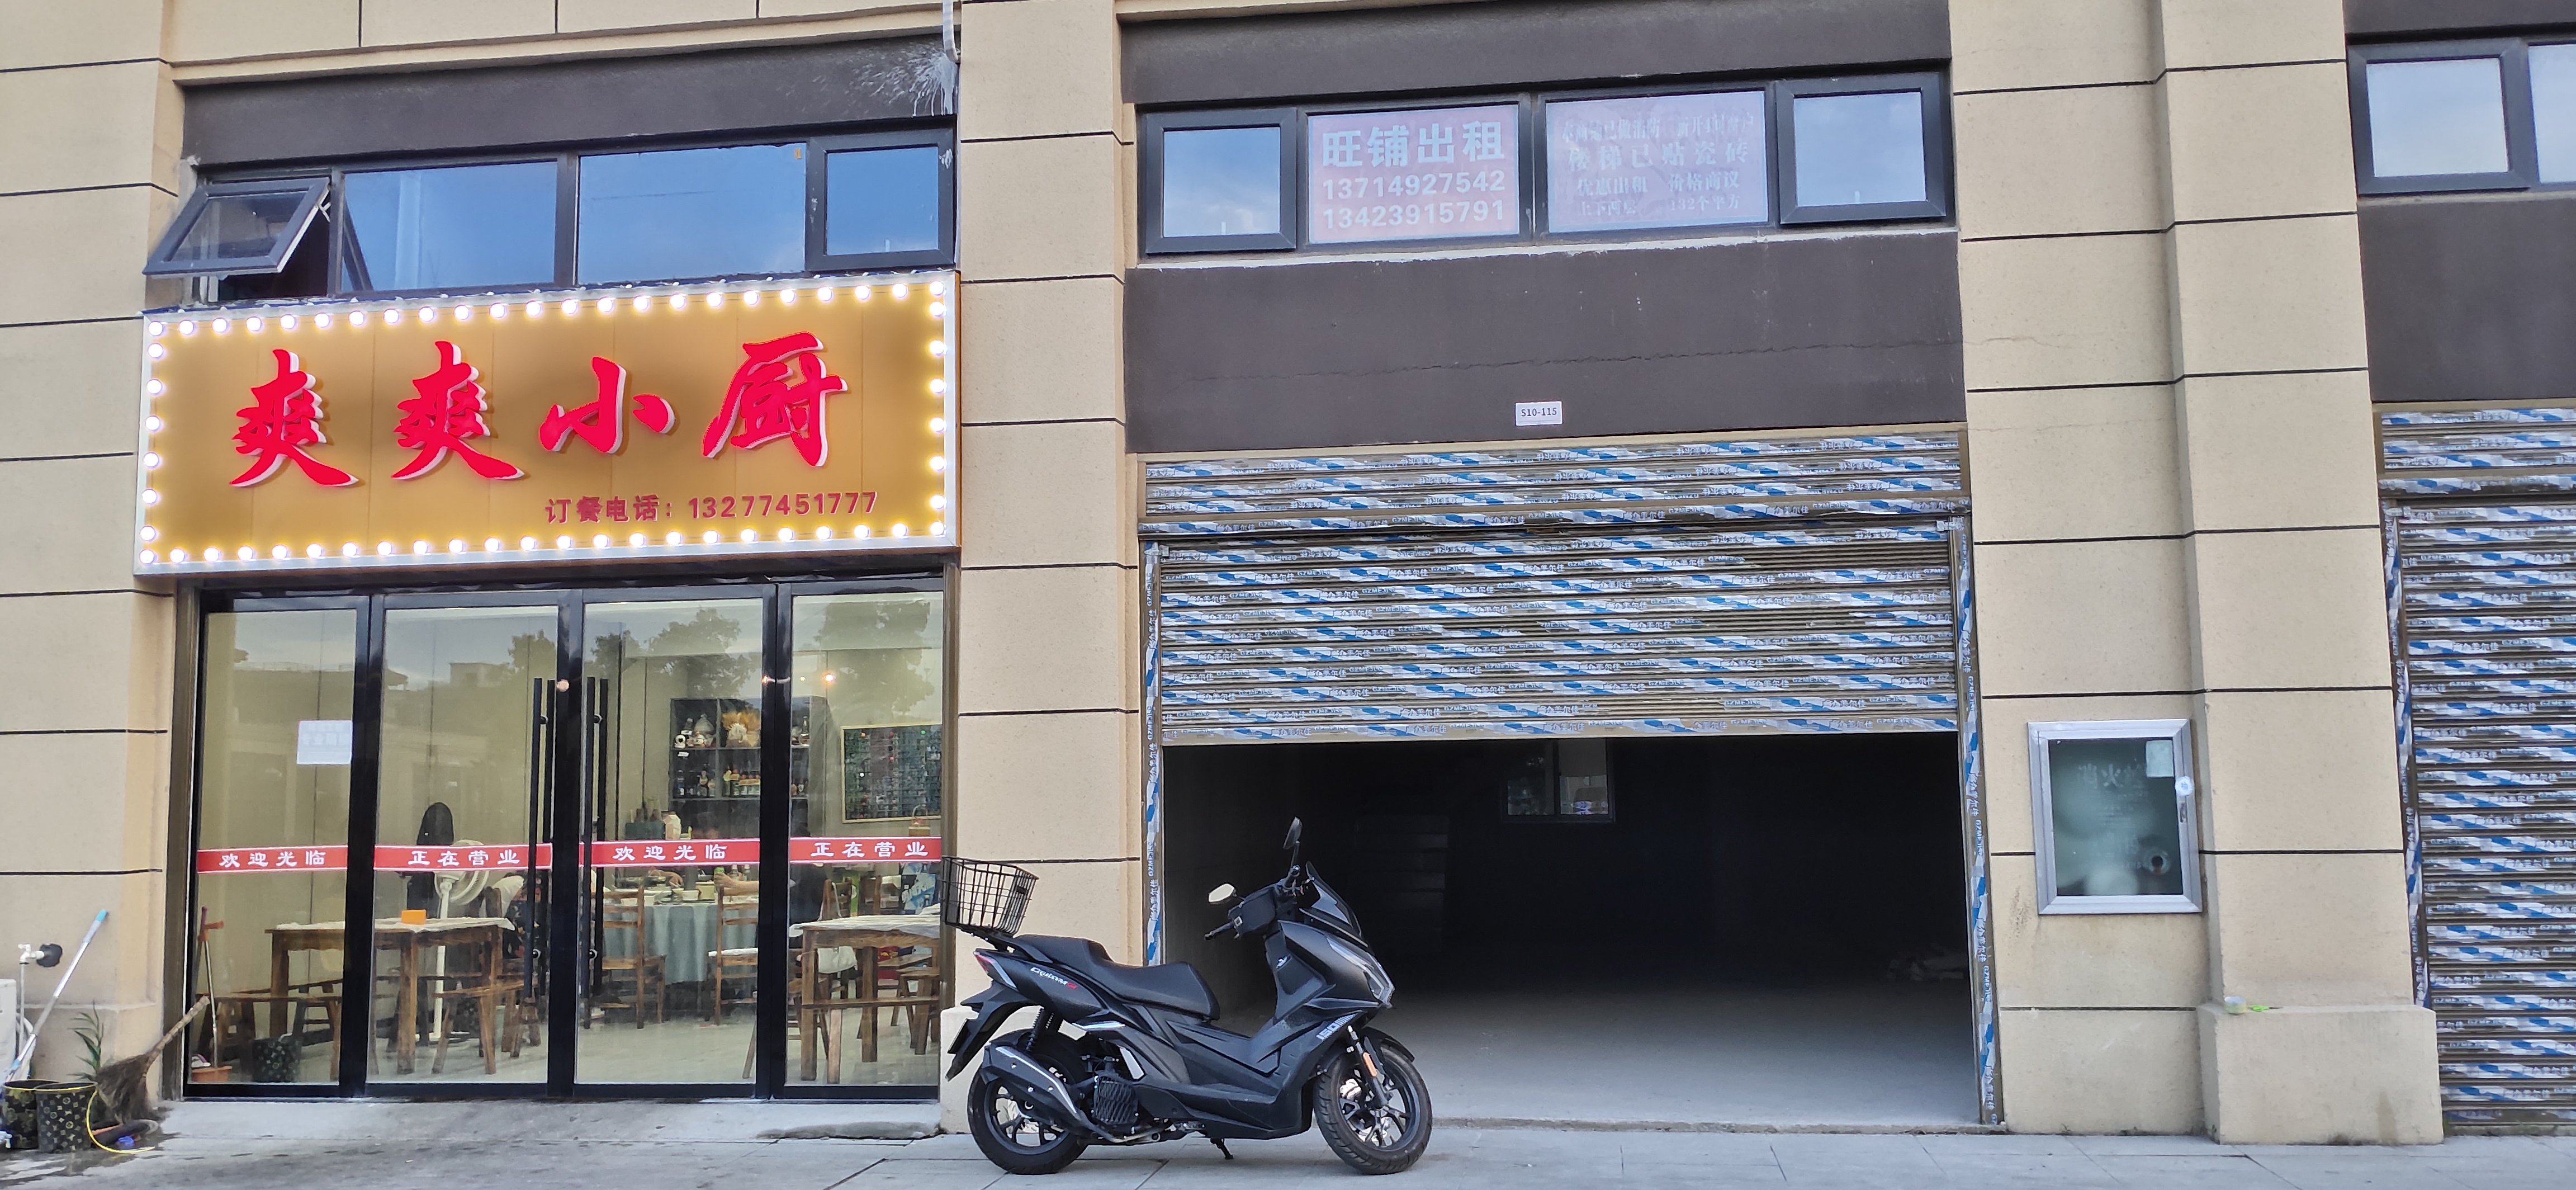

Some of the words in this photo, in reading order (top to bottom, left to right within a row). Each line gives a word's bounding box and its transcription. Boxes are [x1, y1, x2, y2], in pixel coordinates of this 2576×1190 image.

[1323, 120, 1504, 169] 旺铺出租
[1323, 171, 1505, 200] 13714927542
[1324, 200, 1504, 230] 13423915791
[229, 331, 847, 488] 爽爽小厨
[1521, 407, 1557, 417] S10-115
[612, 845, 727, 861] 欢迎光临
[811, 841, 929, 858] 正在营业
[219, 851, 326, 867] 欢迎光临
[408, 851, 520, 867] 正在营业
